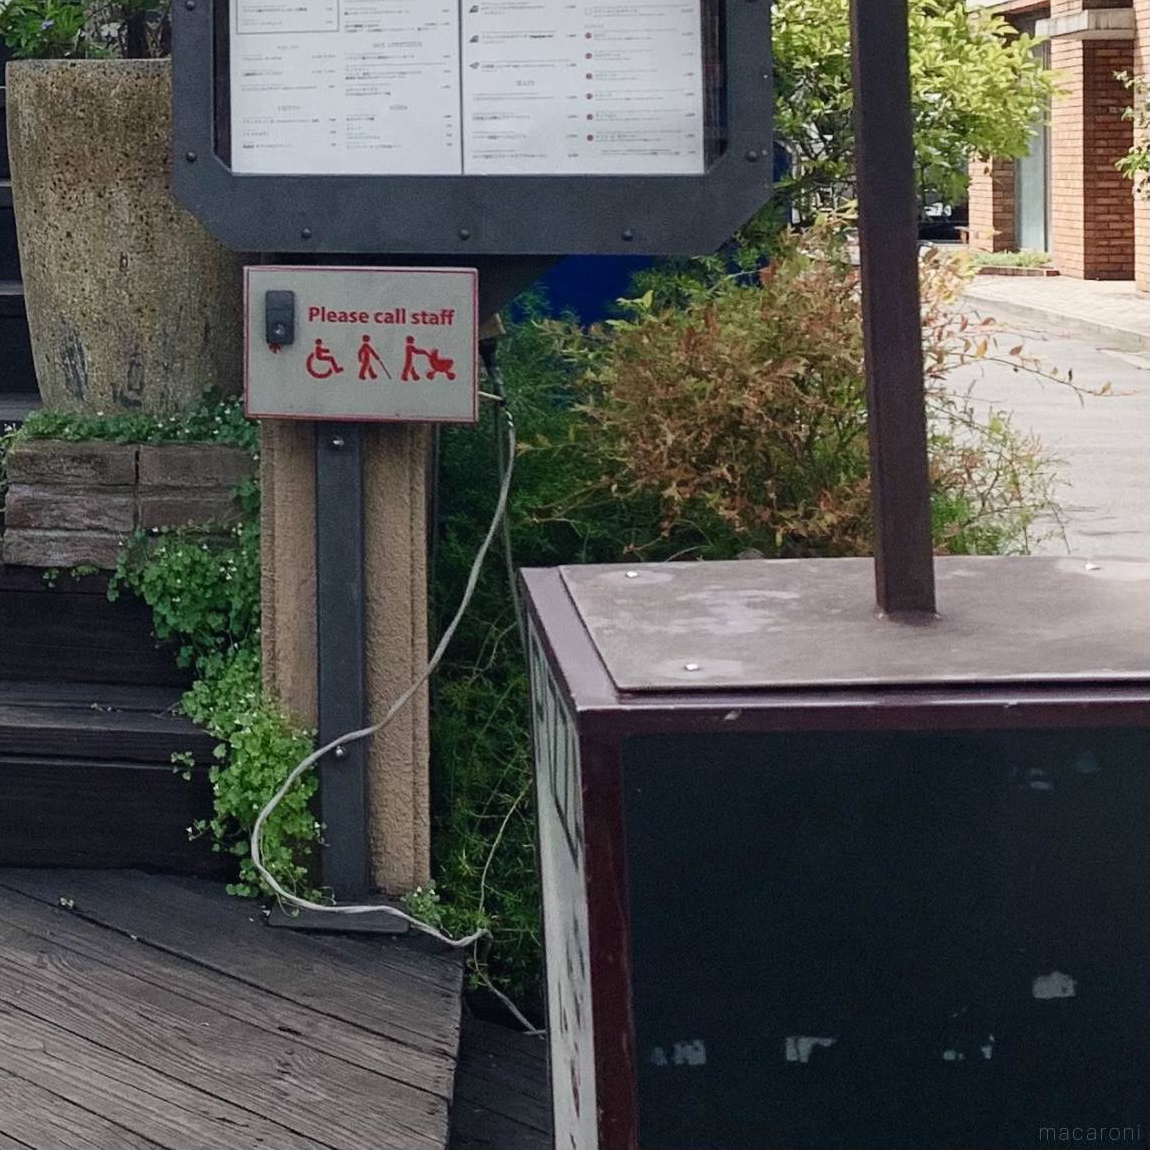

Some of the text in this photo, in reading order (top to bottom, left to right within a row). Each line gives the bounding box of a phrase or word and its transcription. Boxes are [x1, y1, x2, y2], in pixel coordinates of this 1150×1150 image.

[308, 306, 456, 326] Please call staff
